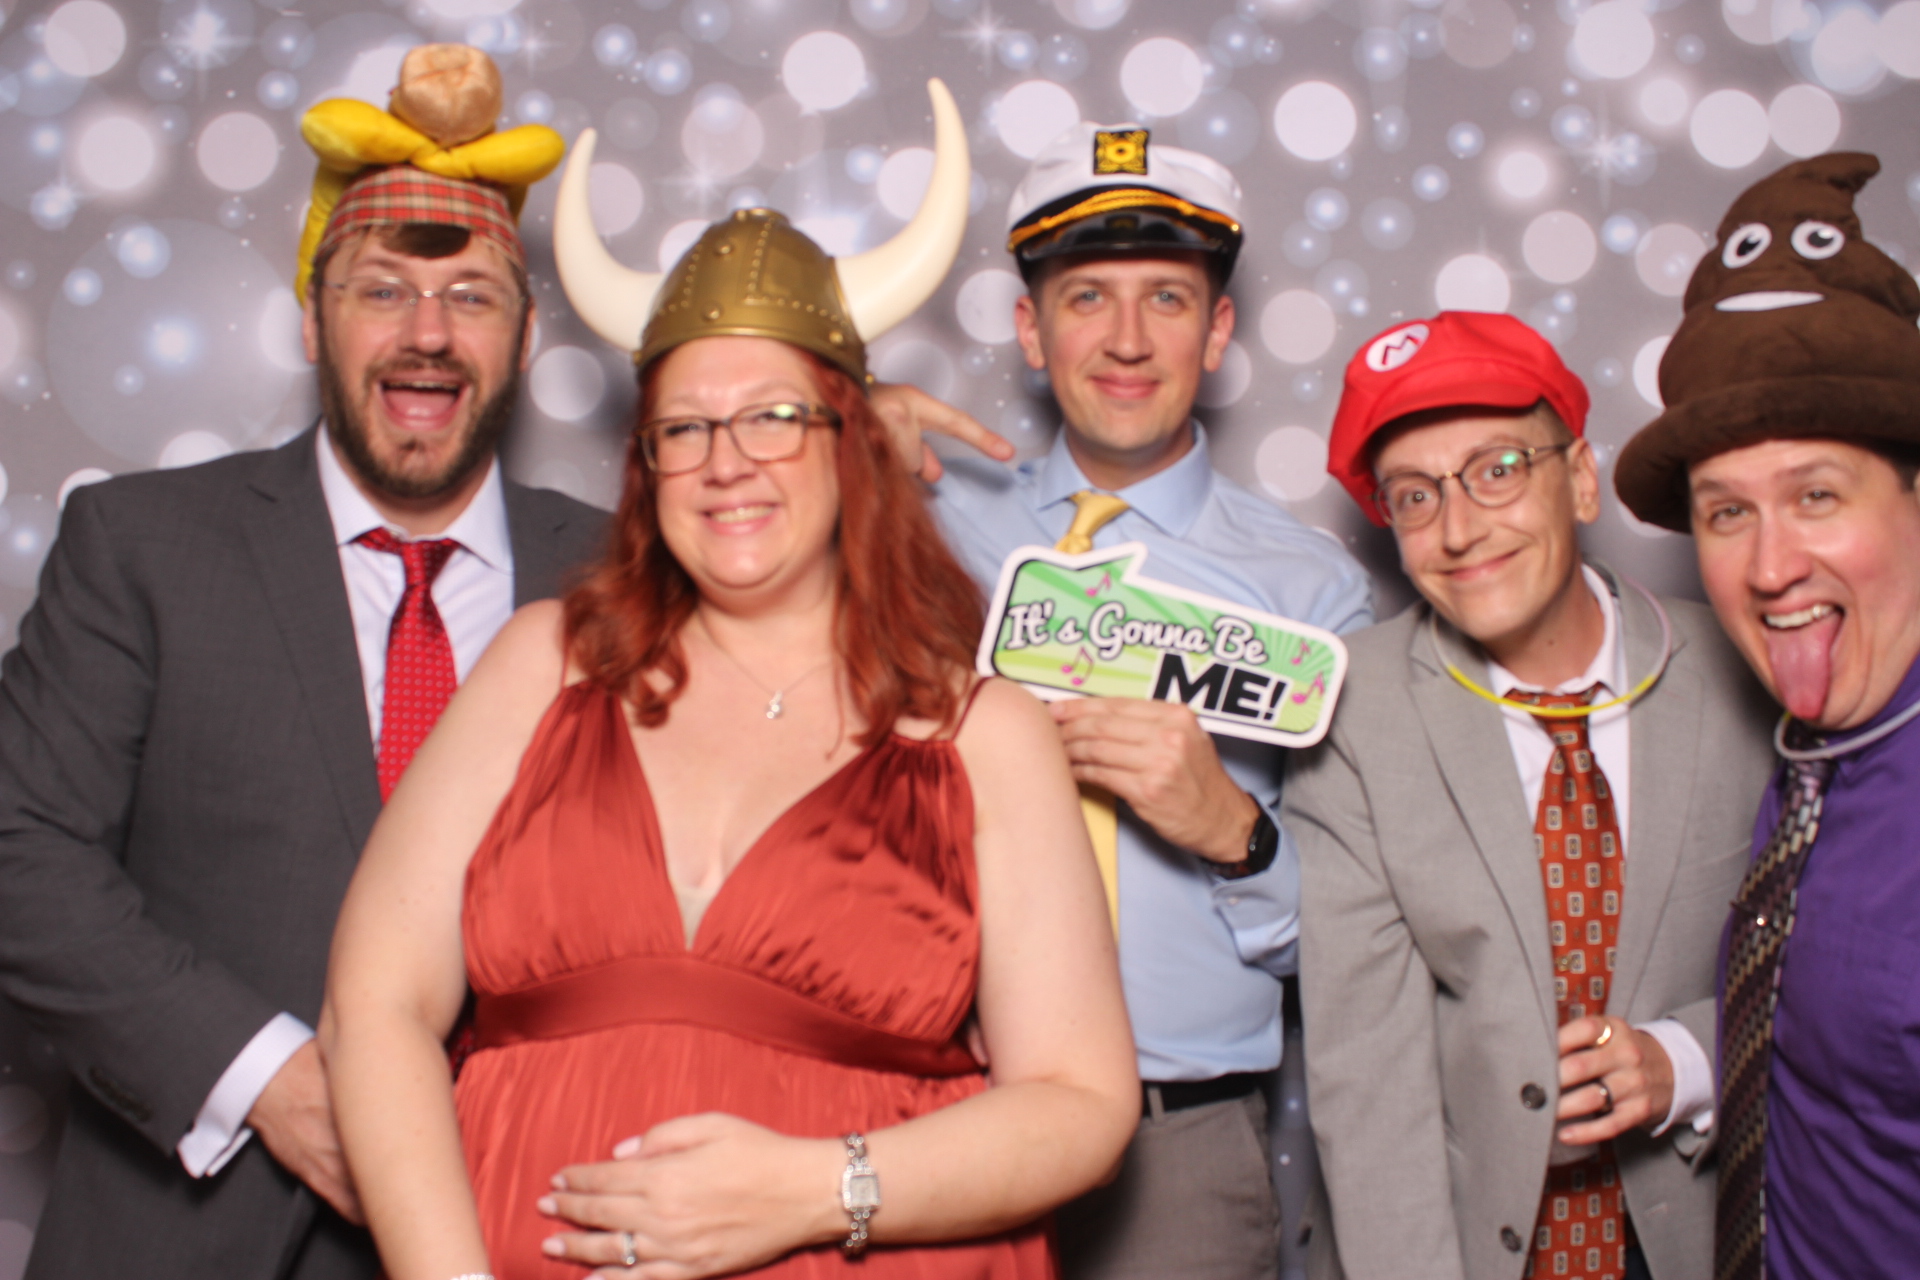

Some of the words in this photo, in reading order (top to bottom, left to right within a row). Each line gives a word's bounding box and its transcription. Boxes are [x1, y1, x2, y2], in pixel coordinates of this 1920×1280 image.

[1381, 334, 1420, 366] M
[1006, 601, 1083, 648] It's
[1089, 602, 1209, 660] Gonna
[1213, 616, 1267, 664] Be
[1153, 652, 1287, 721] ME!
